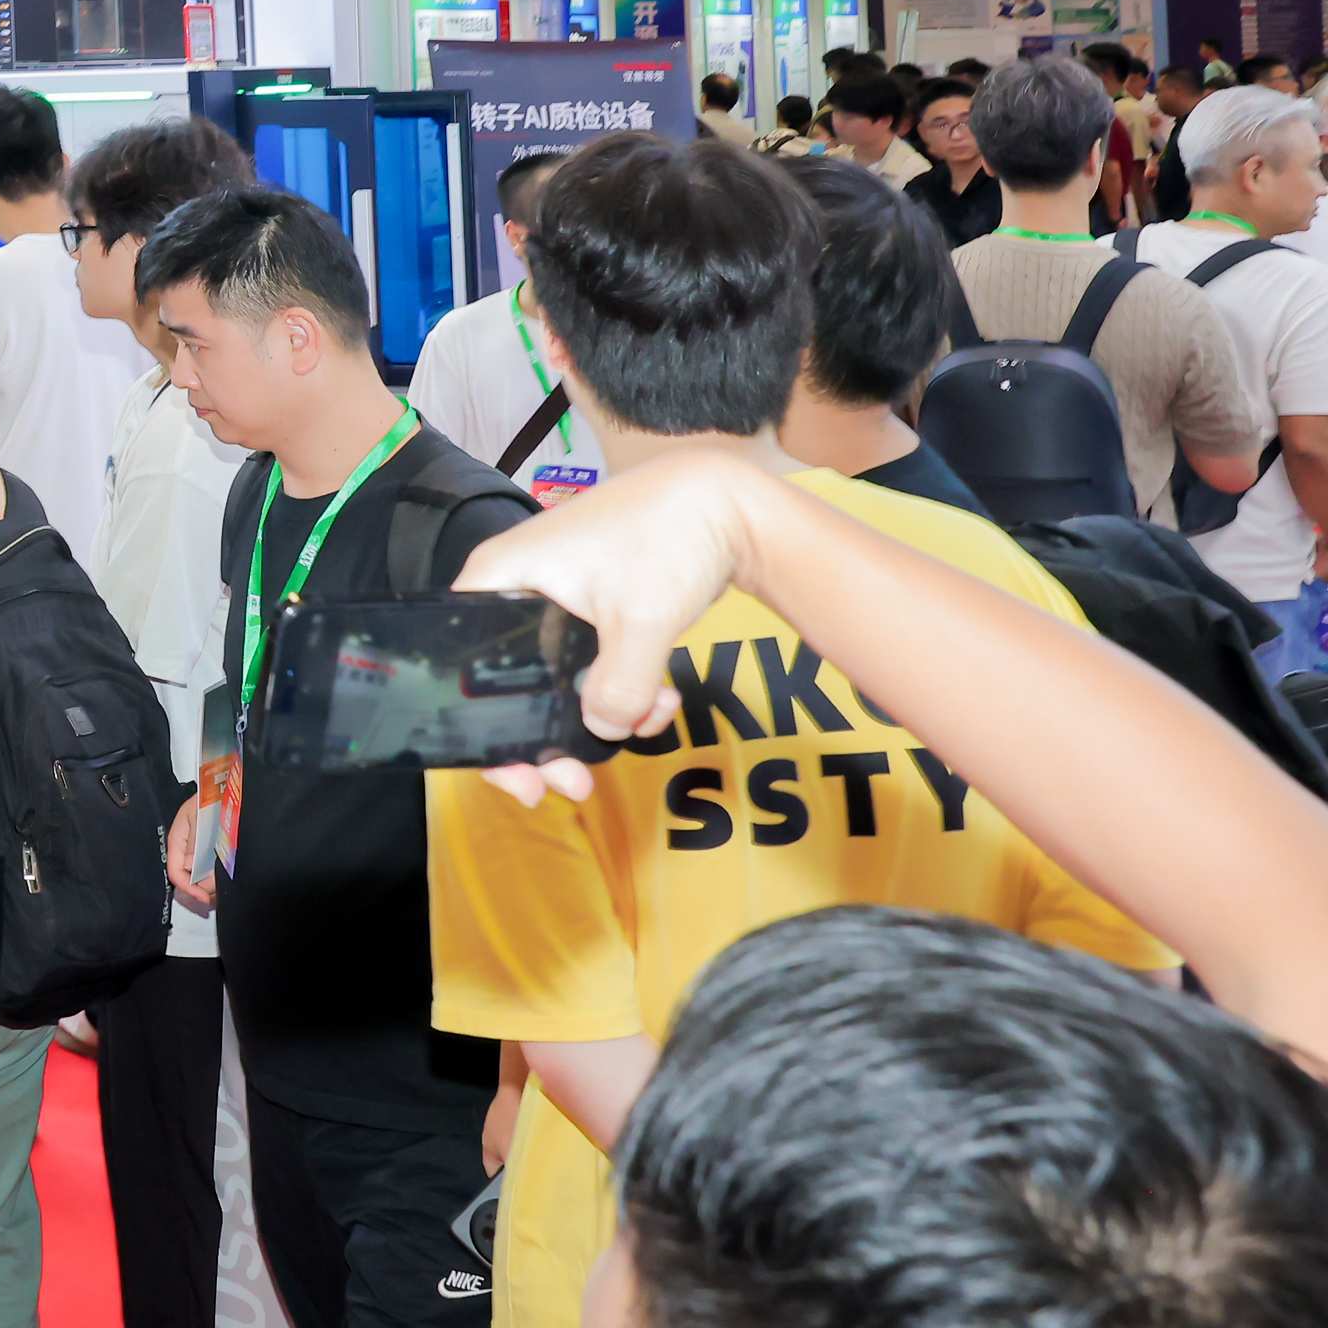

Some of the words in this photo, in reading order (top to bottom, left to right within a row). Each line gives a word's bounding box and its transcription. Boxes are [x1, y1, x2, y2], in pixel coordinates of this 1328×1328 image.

[471, 99, 655, 132] 转子AI质检设备
[664, 746, 971, 850] SSTY
[446, 1270, 485, 1292] NIKE
